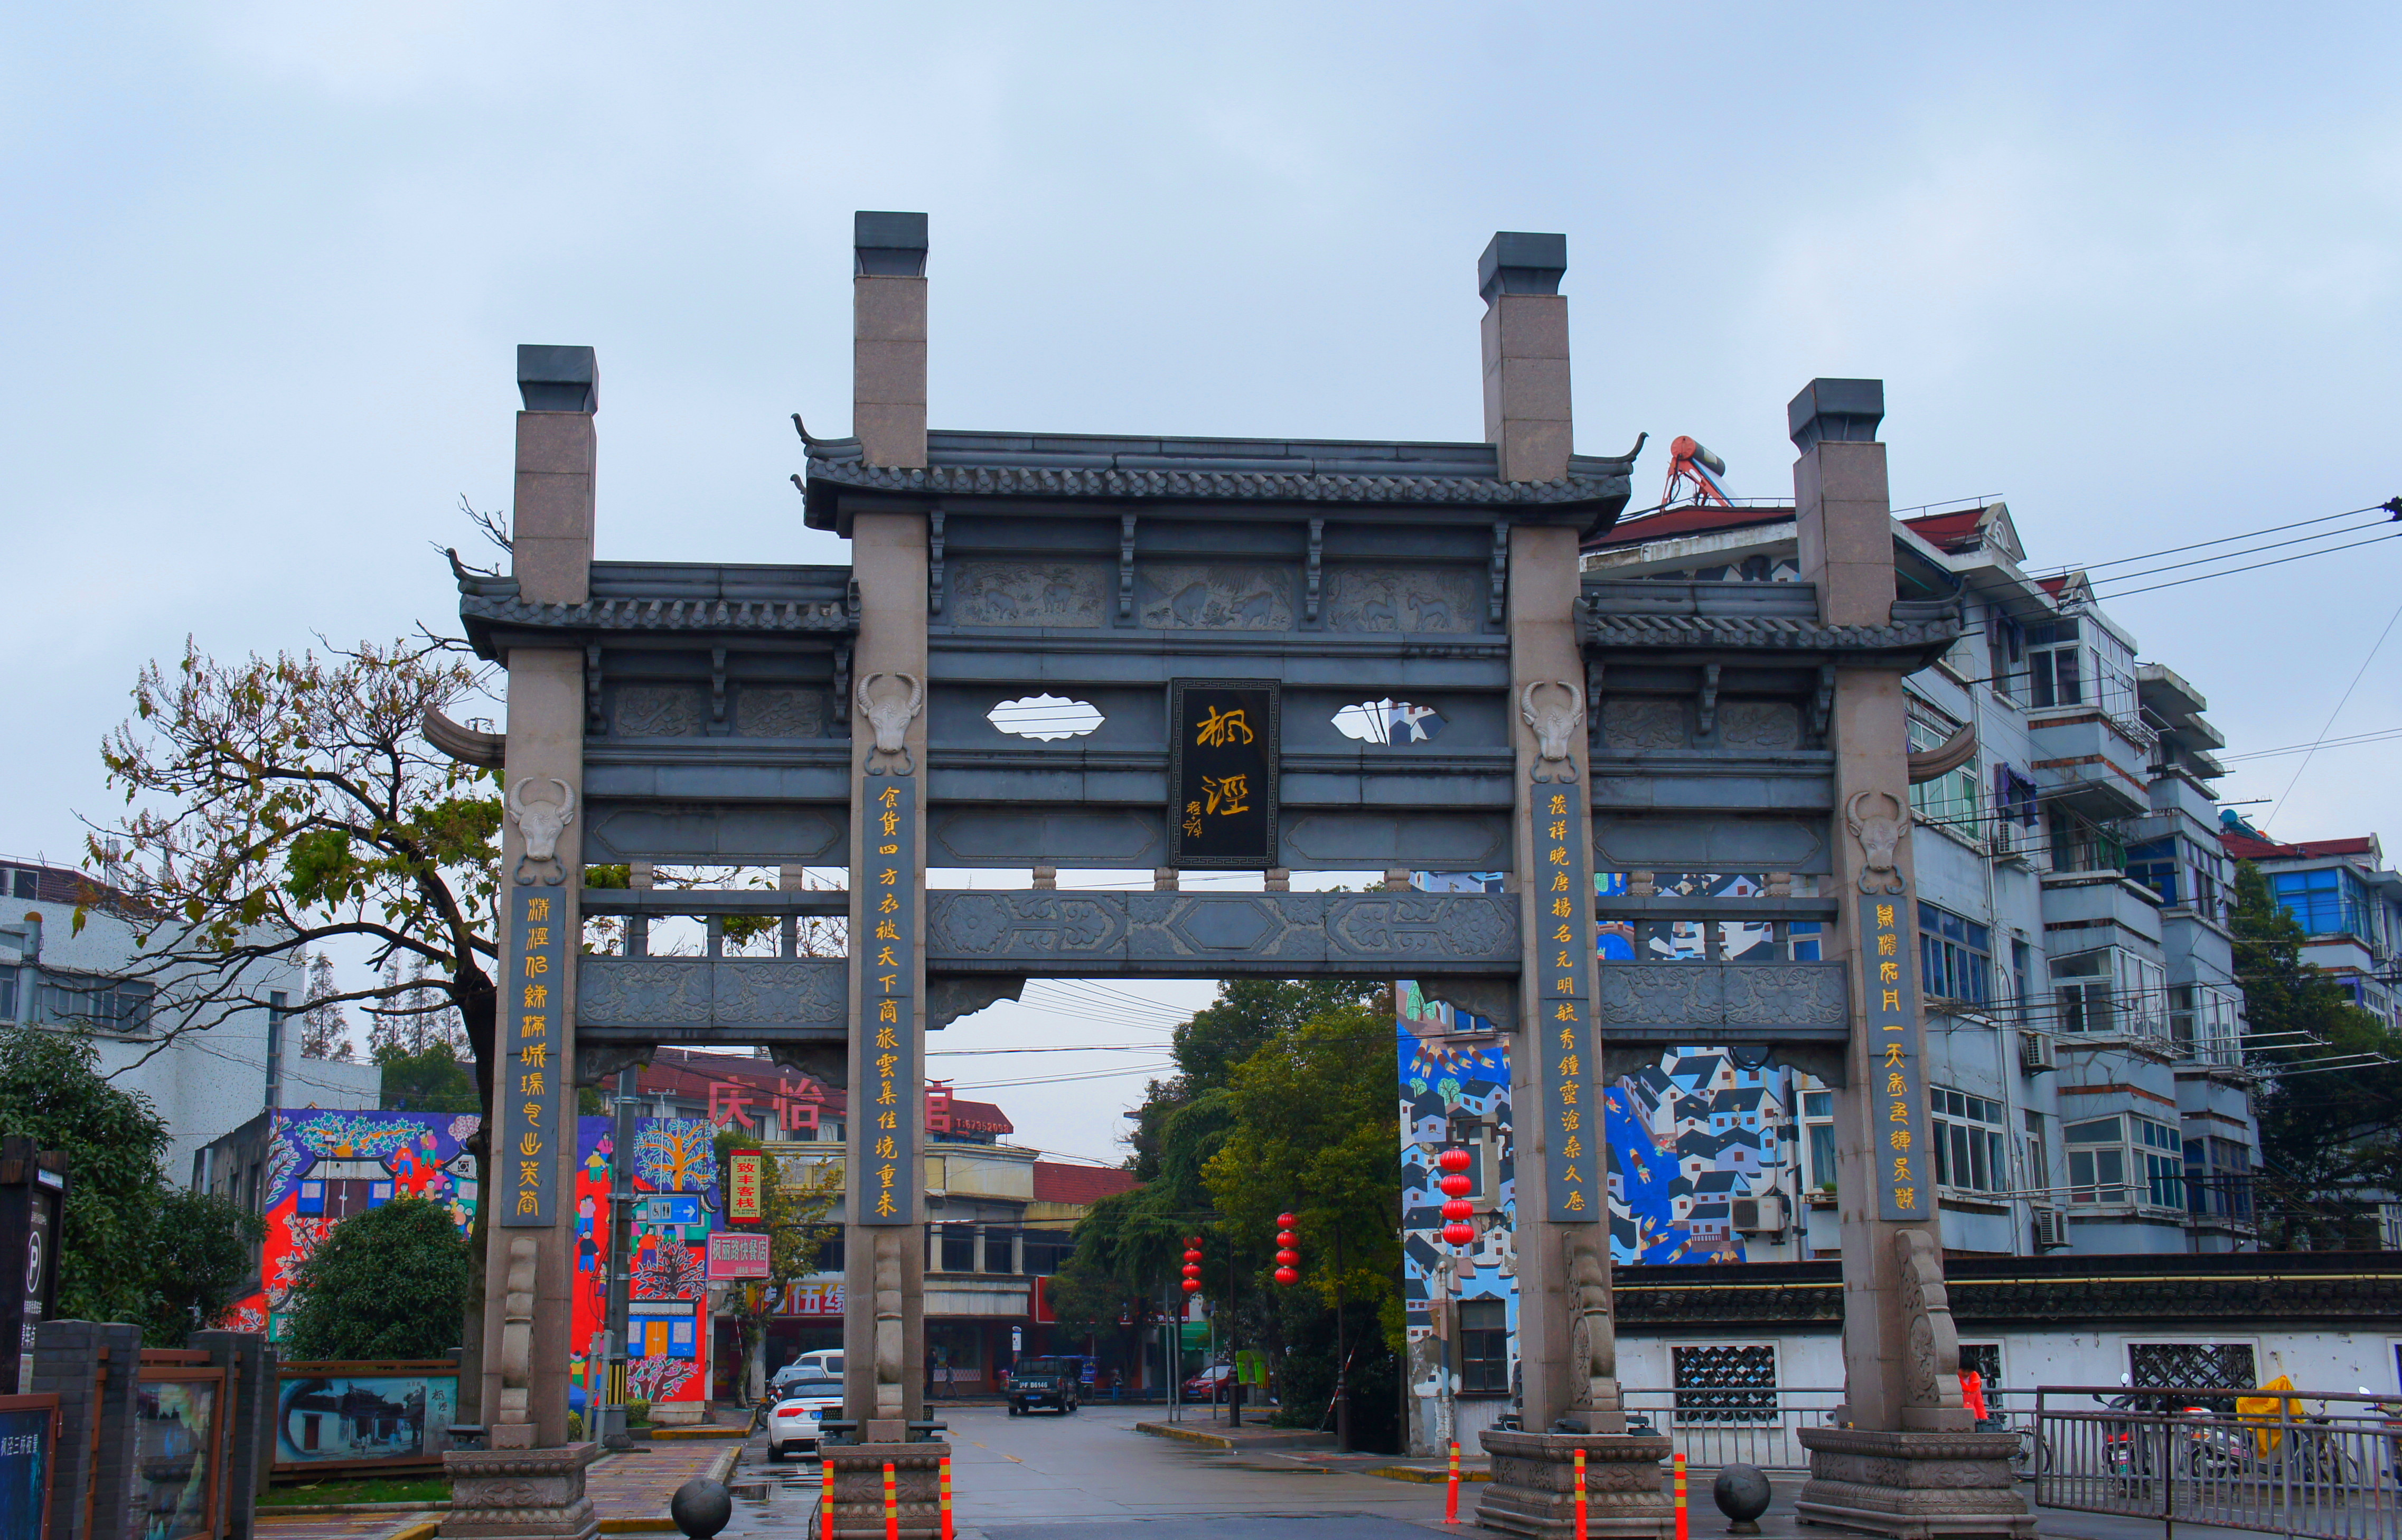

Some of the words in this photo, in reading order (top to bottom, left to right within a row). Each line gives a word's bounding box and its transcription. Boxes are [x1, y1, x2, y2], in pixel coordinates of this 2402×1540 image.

[736, 1163, 756, 1208] 致丰客栈
[712, 1238, 766, 1261] 枫丽路快餐店
